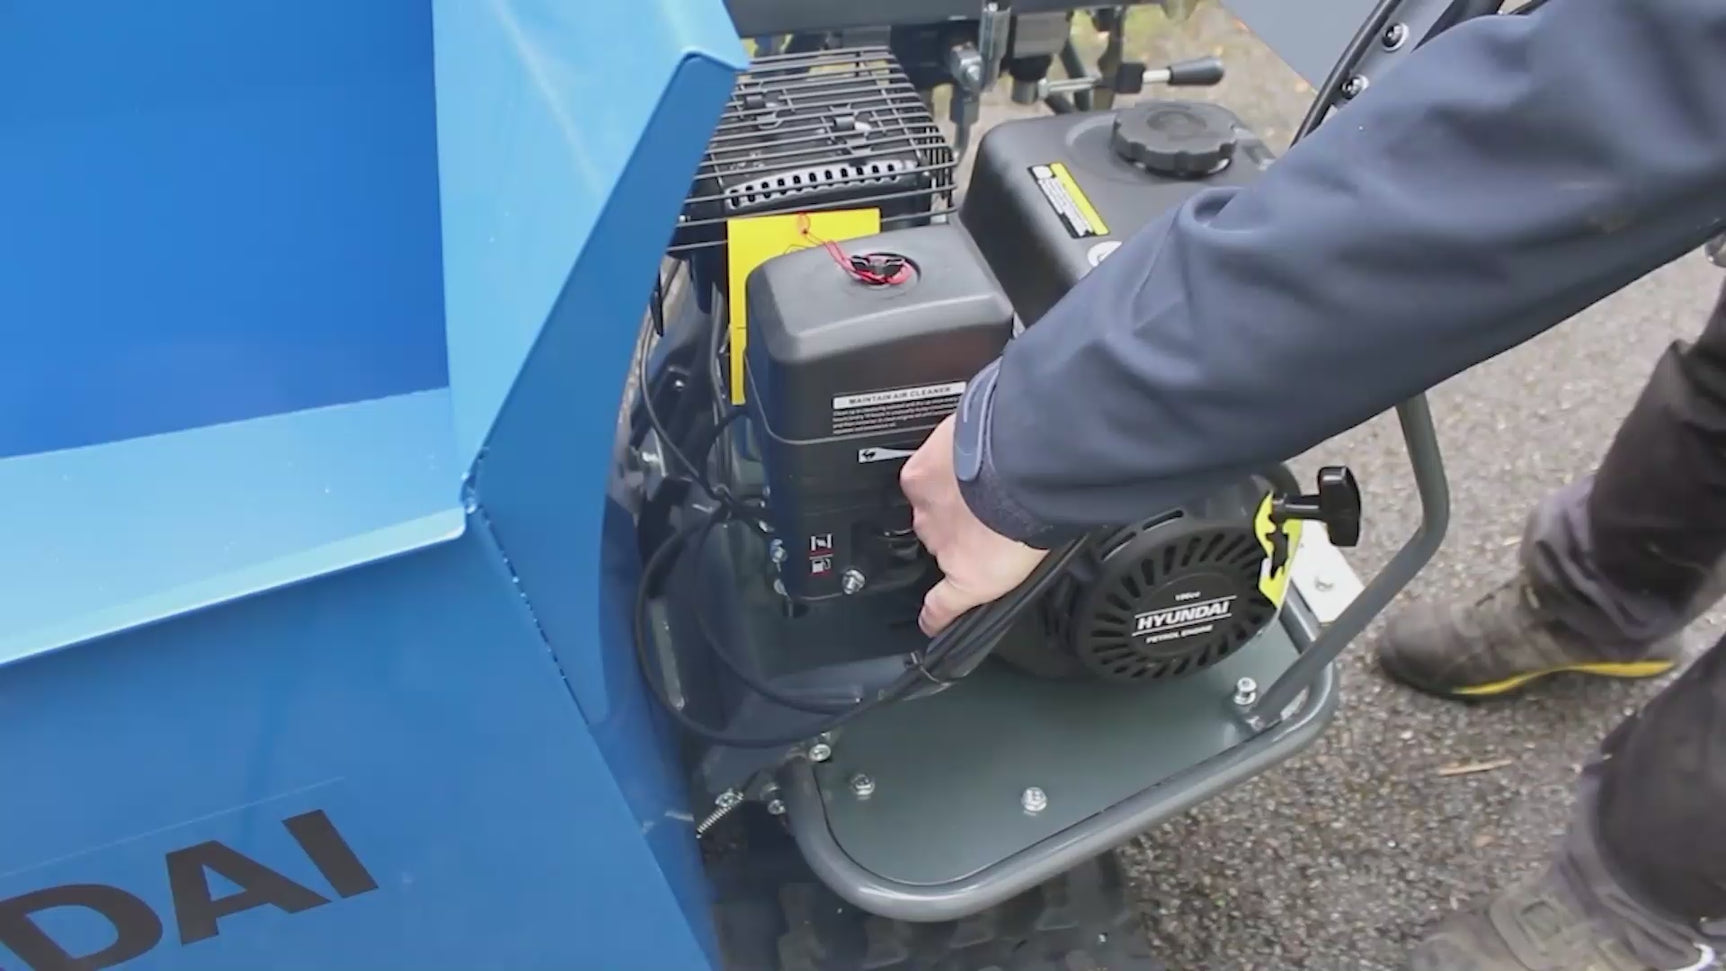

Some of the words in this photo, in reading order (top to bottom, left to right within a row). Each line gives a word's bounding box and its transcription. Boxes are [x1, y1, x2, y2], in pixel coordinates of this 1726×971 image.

[849, 394, 892, 404] MAINTAIN
[893, 391, 908, 399] AIR
[910, 387, 951, 397] CLEANER
[1137, 600, 1230, 630] HYUNDAI
[0, 809, 379, 971] DAI
